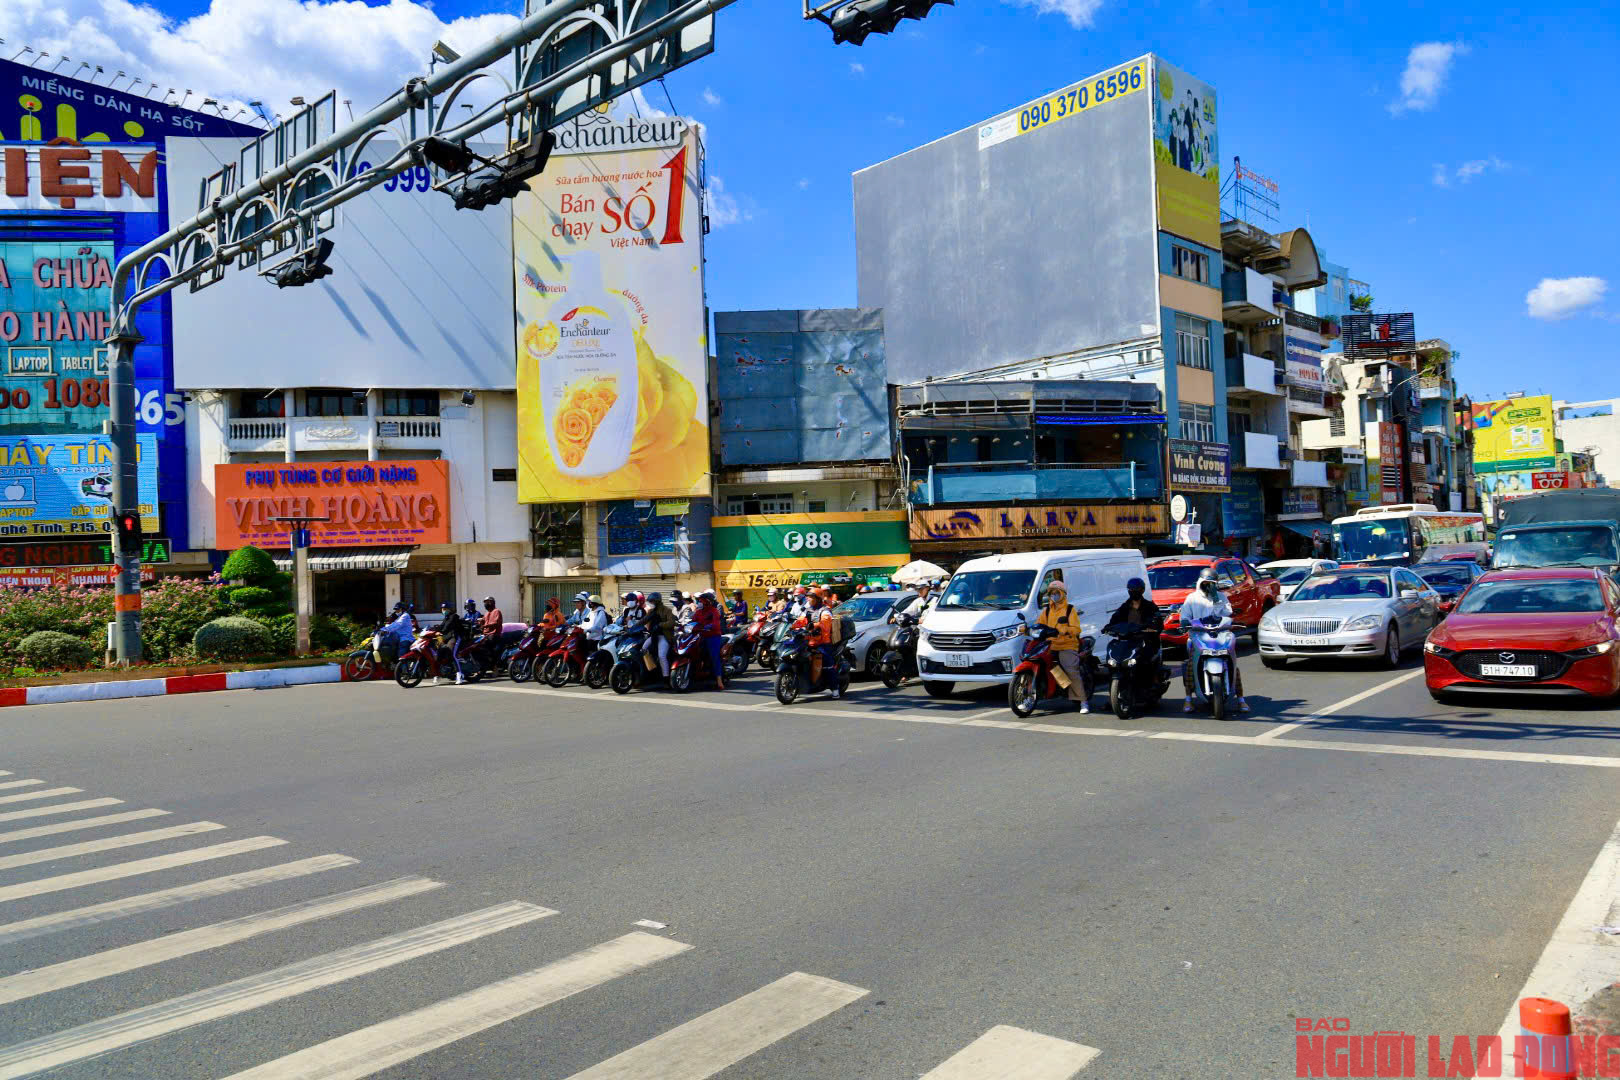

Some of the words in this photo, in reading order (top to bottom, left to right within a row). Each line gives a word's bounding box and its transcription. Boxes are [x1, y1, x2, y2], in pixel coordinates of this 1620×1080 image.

[22, 75, 84, 101] MIẾNG
[94, 94, 131, 114] DÁN
[140, 107, 164, 123] HẠ
[172, 115, 204, 132] SỐT
[1021, 102, 1050, 131] 090
[1057, 87, 1088, 117] 370
[1095, 66, 1141, 102] 8596
[561, 193, 595, 214] Bán
[660, 145, 688, 244] 1
[552, 218, 594, 241] chạy
[610, 238, 629, 248] Việt
[631, 237, 653, 246] Nam
[33, 247, 112, 288] CHỮA
[537, 282, 567, 292] Protein
[13, 356, 48, 370] LAPTOP
[60, 356, 93, 370] TABLET
[246, 469, 275, 487] PHỤ
[279, 466, 317, 484] TÙNG
[226, 497, 309, 528] VINH
[320, 487, 435, 525] HOÀNG
[1000, 511, 1096, 528] LARVA
[784, 531, 832, 551] F88
[749, 575, 764, 587] 15
